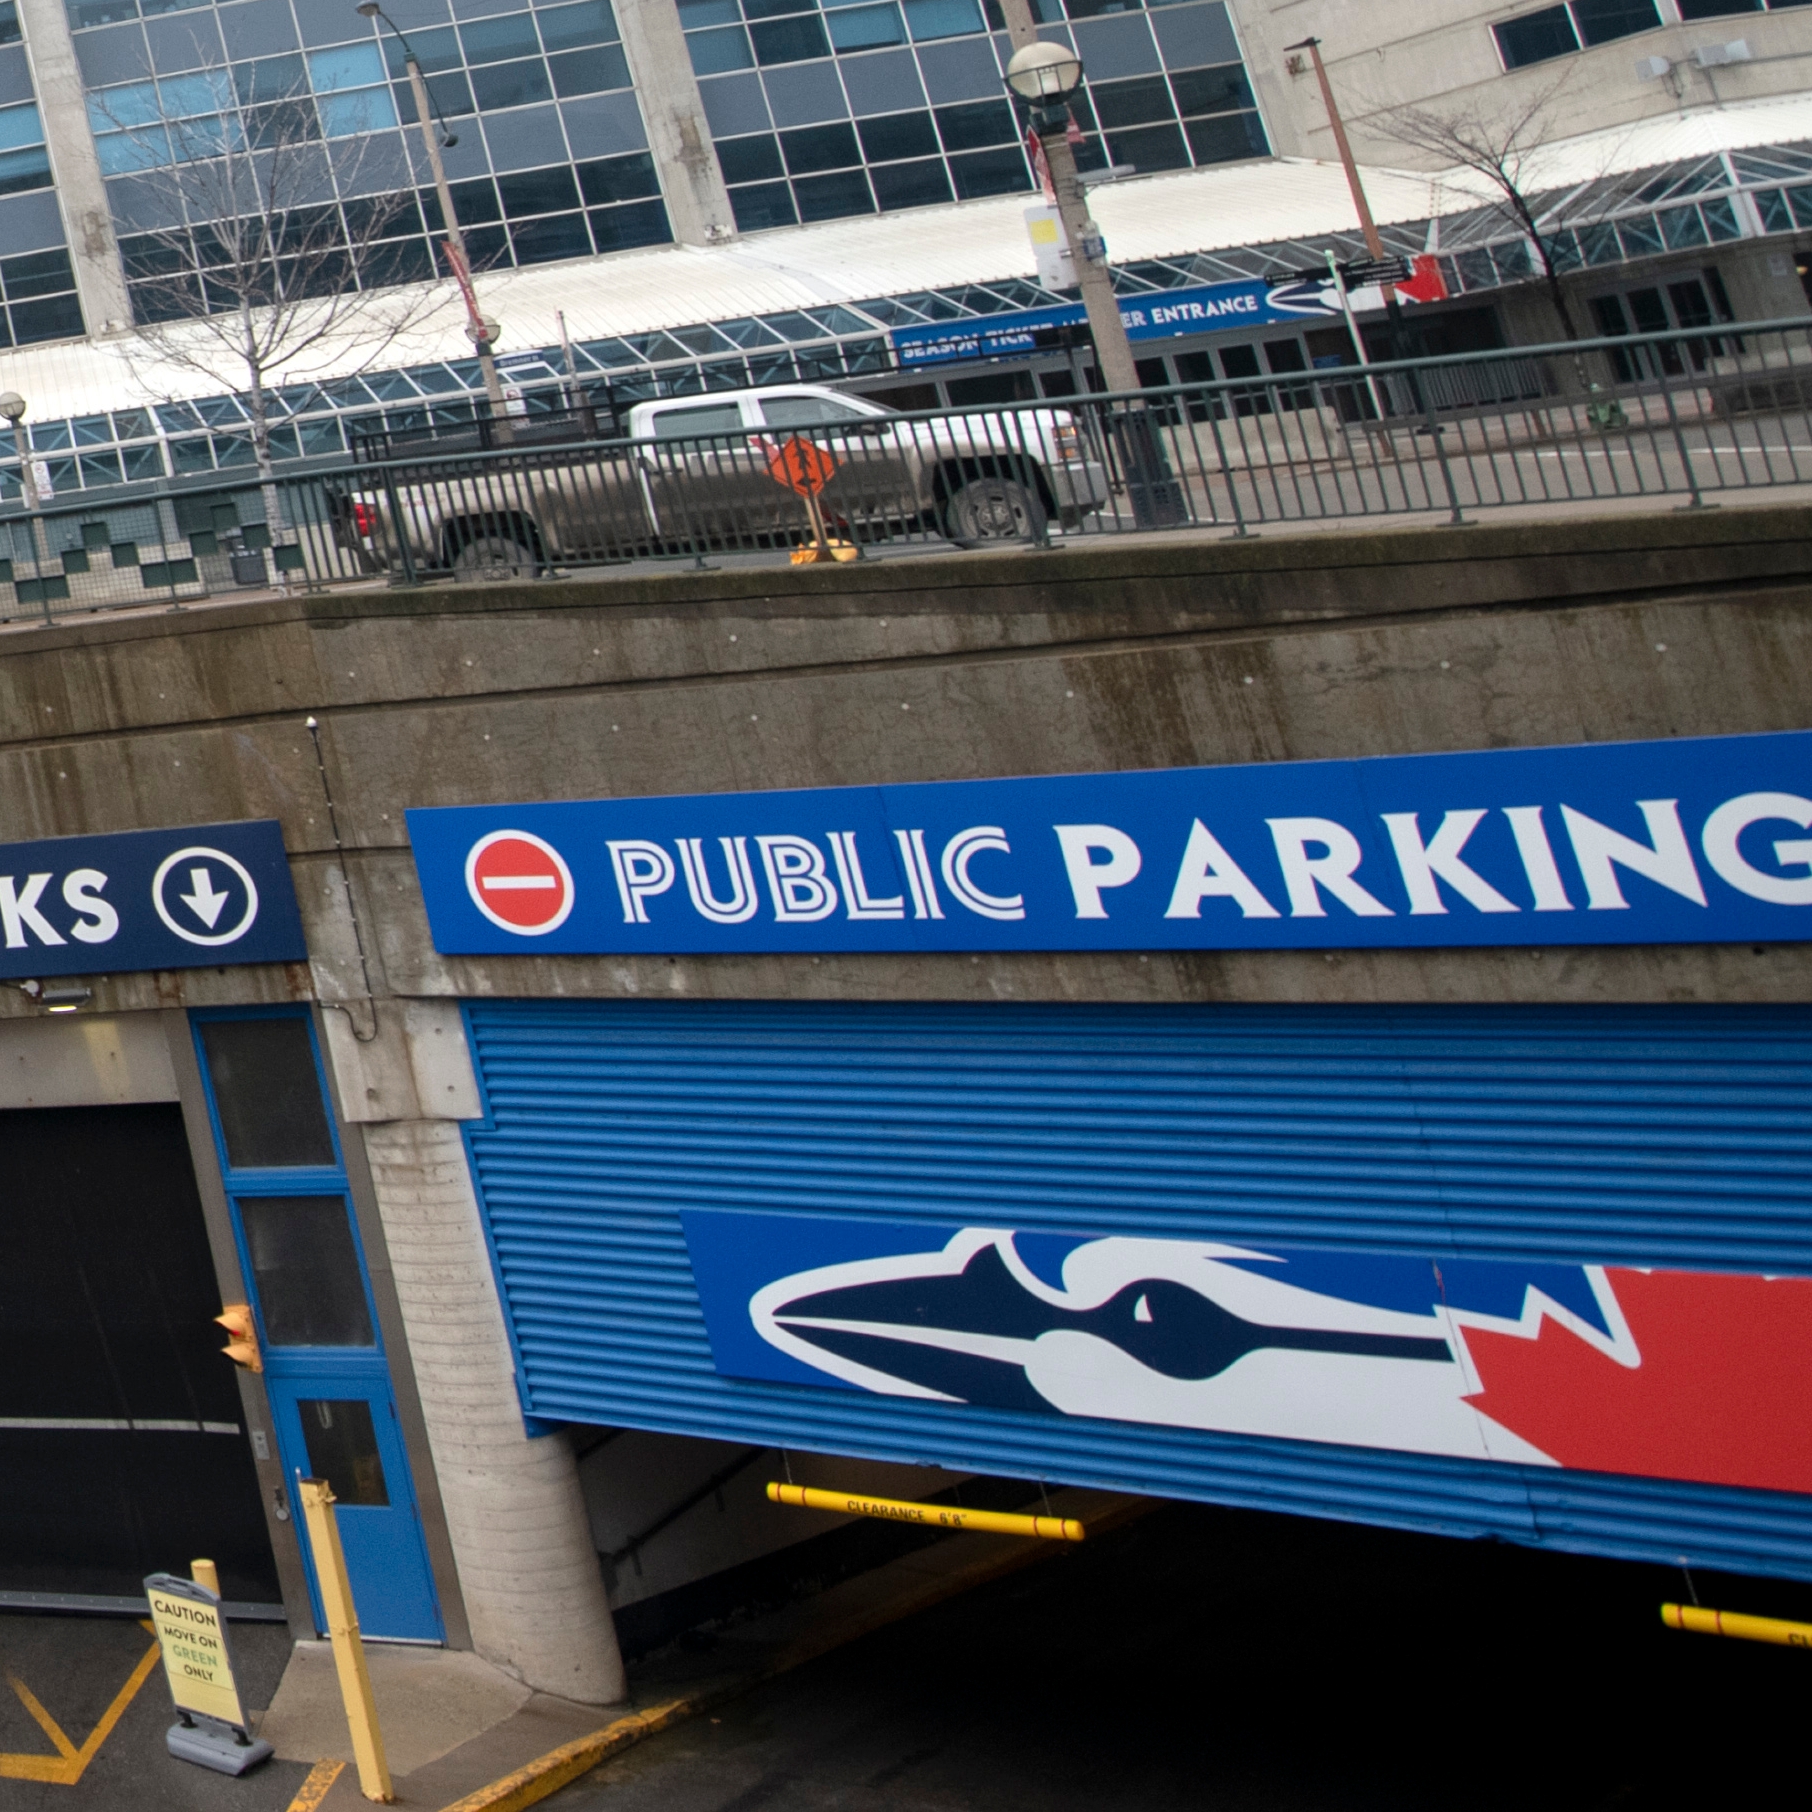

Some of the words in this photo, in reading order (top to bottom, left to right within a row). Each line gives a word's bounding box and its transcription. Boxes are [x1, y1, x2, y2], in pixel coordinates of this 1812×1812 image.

[1152, 294, 1258, 325] ENTRANCE
[605, 826, 1025, 924] PUBLIC
[1052, 791, 1812, 919] PARKING
[847, 1500, 924, 1522] CLEARANCE
[940, 1511, 967, 1526] 6'8"
[154, 1600, 216, 1627] CAUTION
[164, 1626, 197, 1644] MOVE
[199, 1636, 217, 1649] ON
[173, 1645, 217, 1666] GREEN
[184, 1664, 213, 1682] ONLY
